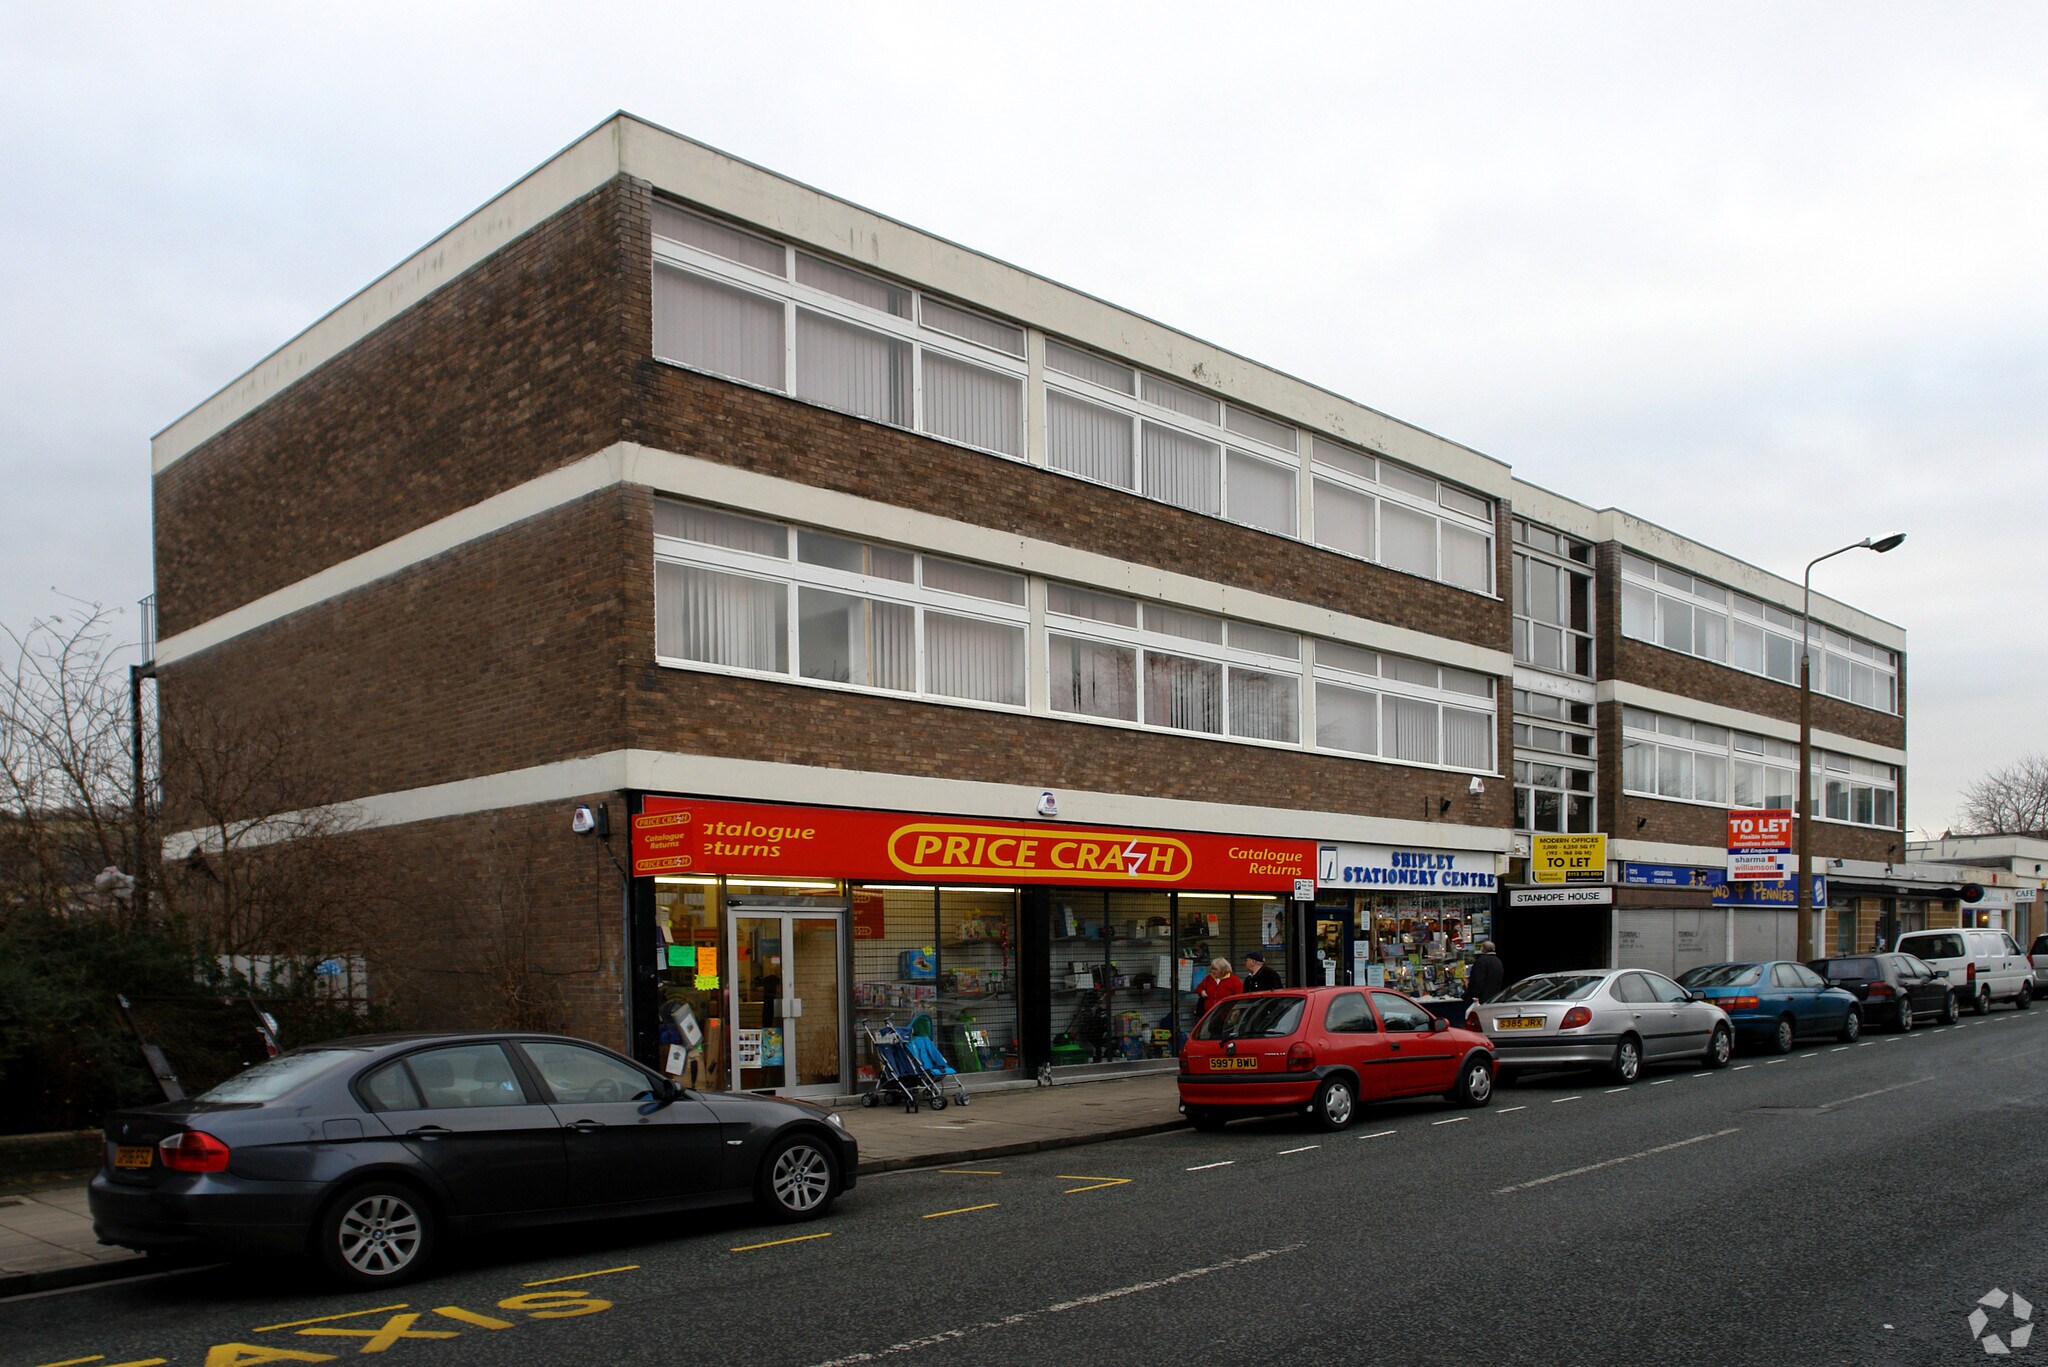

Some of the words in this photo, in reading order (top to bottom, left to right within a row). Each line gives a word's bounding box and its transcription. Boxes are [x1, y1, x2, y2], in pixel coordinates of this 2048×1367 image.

[639, 815, 660, 827] PRICE
[1730, 819, 1753, 833] TO
[1758, 818, 1790, 833] LET
[644, 832, 684, 844] Catalogue
[703, 821, 816, 843] atalogue
[650, 840, 680, 850] Returns
[704, 841, 781, 857] eturns
[913, 835, 1039, 867] PRICE
[1228, 847, 1303, 864] Catalogue
[1391, 852, 1455, 870] SHIPLEY
[1547, 858, 1565, 867] TO
[1569, 857, 1590, 867] LET
[639, 859, 661, 869] PRICE
[1249, 862, 1302, 876] Returns
[1343, 866, 1438, 885] STATIONERY
[1442, 871, 1495, 888] CENTRE
[1517, 893, 1564, 902] STANHOPE
[1568, 892, 1600, 900] HOUSE
[1500, 1019, 1522, 1028] S385
[1524, 1018, 1543, 1027] JRX
[1210, 1059, 1234, 1068] S997
[1237, 1058, 1257, 1067] BWU
